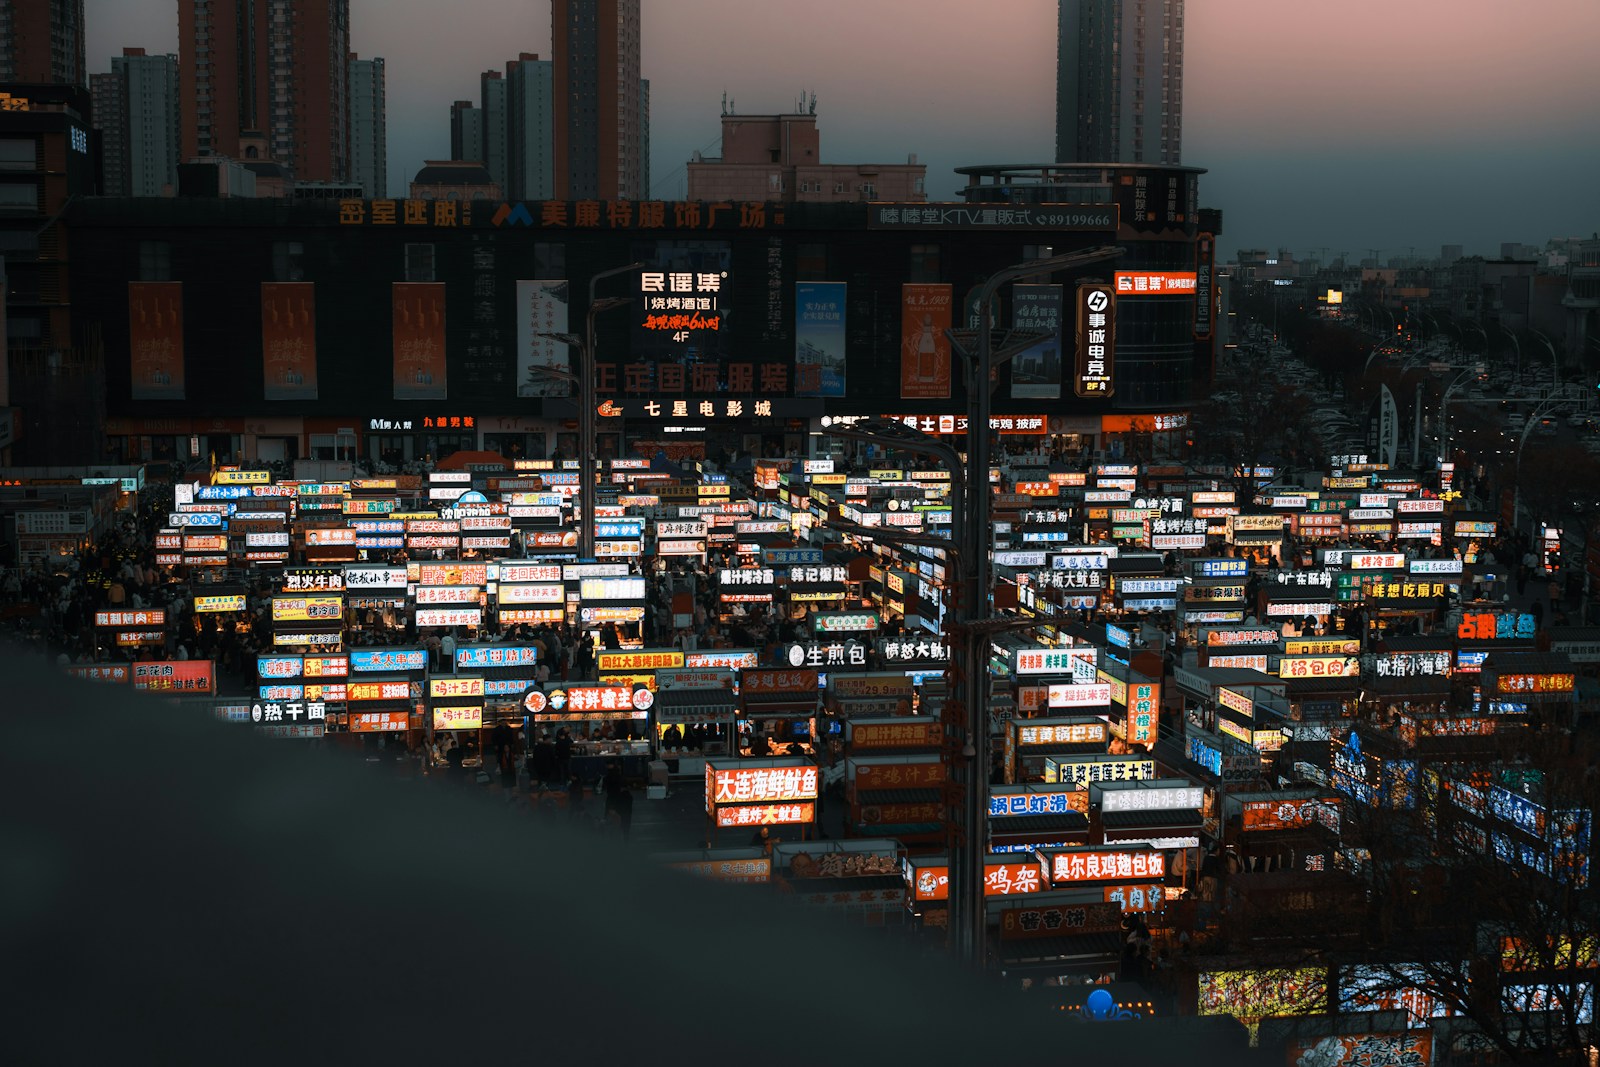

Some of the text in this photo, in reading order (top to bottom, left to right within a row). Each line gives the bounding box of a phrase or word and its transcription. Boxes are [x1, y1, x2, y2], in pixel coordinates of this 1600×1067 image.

[1135, 176, 1147, 222] 潮玩娱乐
[1167, 177, 1177, 222] 精品服饰
[339, 199, 459, 227] 密室逃脱
[541, 200, 766, 228] 美廉特服饰广场
[1049, 213, 1110, 226] 89199666
[641, 271, 721, 293] 民谣集
[1117, 276, 1162, 291] 民谣集
[651, 297, 711, 311] 烧烤酒馆
[642, 311, 721, 331] 每晚演出6小时
[672, 331, 690, 342] 4F
[1088, 313, 1106, 376] 事诚电竞
[595, 362, 823, 393] 正定国际服装城
[1086, 381, 1099, 391] 2F
[643, 400, 772, 418] 七星电影城
[1016, 418, 1042, 430] 披萨
[368, 501, 395, 512] 西瓜汁
[1147, 498, 1183, 513] 烤冷面
[1402, 500, 1443, 512] 东北锅包肉
[465, 518, 503, 527] 脆皮五花肉
[1025, 512, 1068, 522] 广东肠粉
[1152, 518, 1208, 534] 烧烤海鲜
[1027, 532, 1066, 541] 广东肠粉
[1361, 556, 1395, 567] 烤冷面
[422, 572, 446, 585] 里脊
[462, 571, 486, 585] 肉饼
[508, 567, 560, 580] 老回民炸串
[720, 569, 774, 585] 爆汁烤冷面
[791, 568, 847, 583] 韩记爆肚
[1037, 571, 1101, 589] 铁板大鱿鱼
[1284, 572, 1332, 588] 广东肠粉
[287, 575, 343, 589] 烈火牛肉
[419, 589, 467, 602] 特色馄饨面
[513, 588, 558, 598] 云朵舒芙蕾
[1193, 587, 1243, 598] 老北京爆肚
[1373, 583, 1445, 598] 蚝想吃扇贝
[307, 605, 339, 617] 烤冷面
[418, 613, 480, 625] 大馅吉祥馄饨
[459, 648, 535, 662] 小马哥烧烤
[806, 644, 866, 667] 生煎包
[884, 641, 951, 661] 愤怒大鱿
[267, 660, 303, 676] 现榨果汁
[601, 655, 673, 668] 网红大葱烤肥肠
[1290, 660, 1344, 676] 锅包肉
[67, 668, 125, 679] 川花甲粉
[135, 665, 173, 676] 五花肉
[435, 681, 481, 696] 鸡汁豆腐
[1064, 689, 1110, 702] 提拉米苏
[569, 689, 632, 709] 海鲜霸主
[264, 702, 326, 722] 热干面
[443, 709, 481, 721] 鸡汁豆腐
[1136, 686, 1152, 741] 鲜榨橙汁
[1061, 762, 1154, 783] 爆浆榴莲芝士饼
[717, 770, 817, 802] 大连海鲜鱿鱼
[991, 793, 1069, 814] 锅巴虾滑
[737, 804, 803, 825] 轰炸大鱿鱼
[1054, 852, 1165, 880] 奥尔良鸡翅包饭
[1019, 908, 1087, 931] 酱香饼
